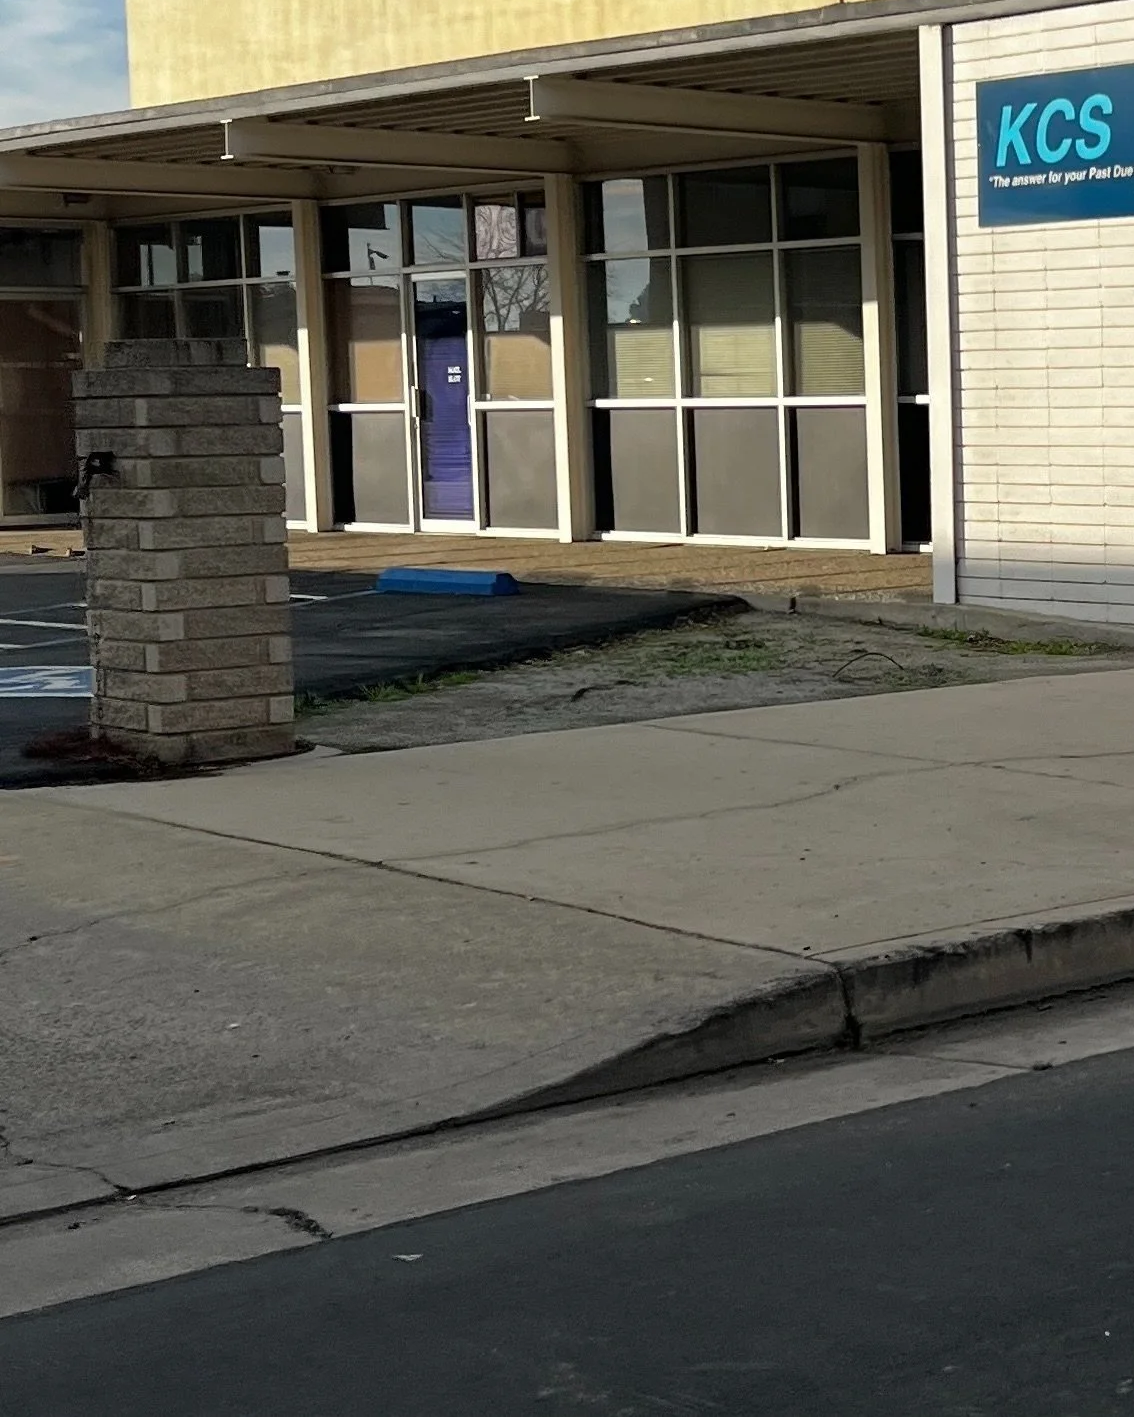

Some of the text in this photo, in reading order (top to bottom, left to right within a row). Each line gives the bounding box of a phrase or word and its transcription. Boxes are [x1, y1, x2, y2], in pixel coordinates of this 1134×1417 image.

[996, 93, 1113, 167] KCS
[1011, 173, 1046, 187] answer
[1048, 170, 1063, 184] for
[1063, 169, 1086, 186] your
[1089, 166, 1111, 180] Past
[1113, 164, 1133, 178] Due
